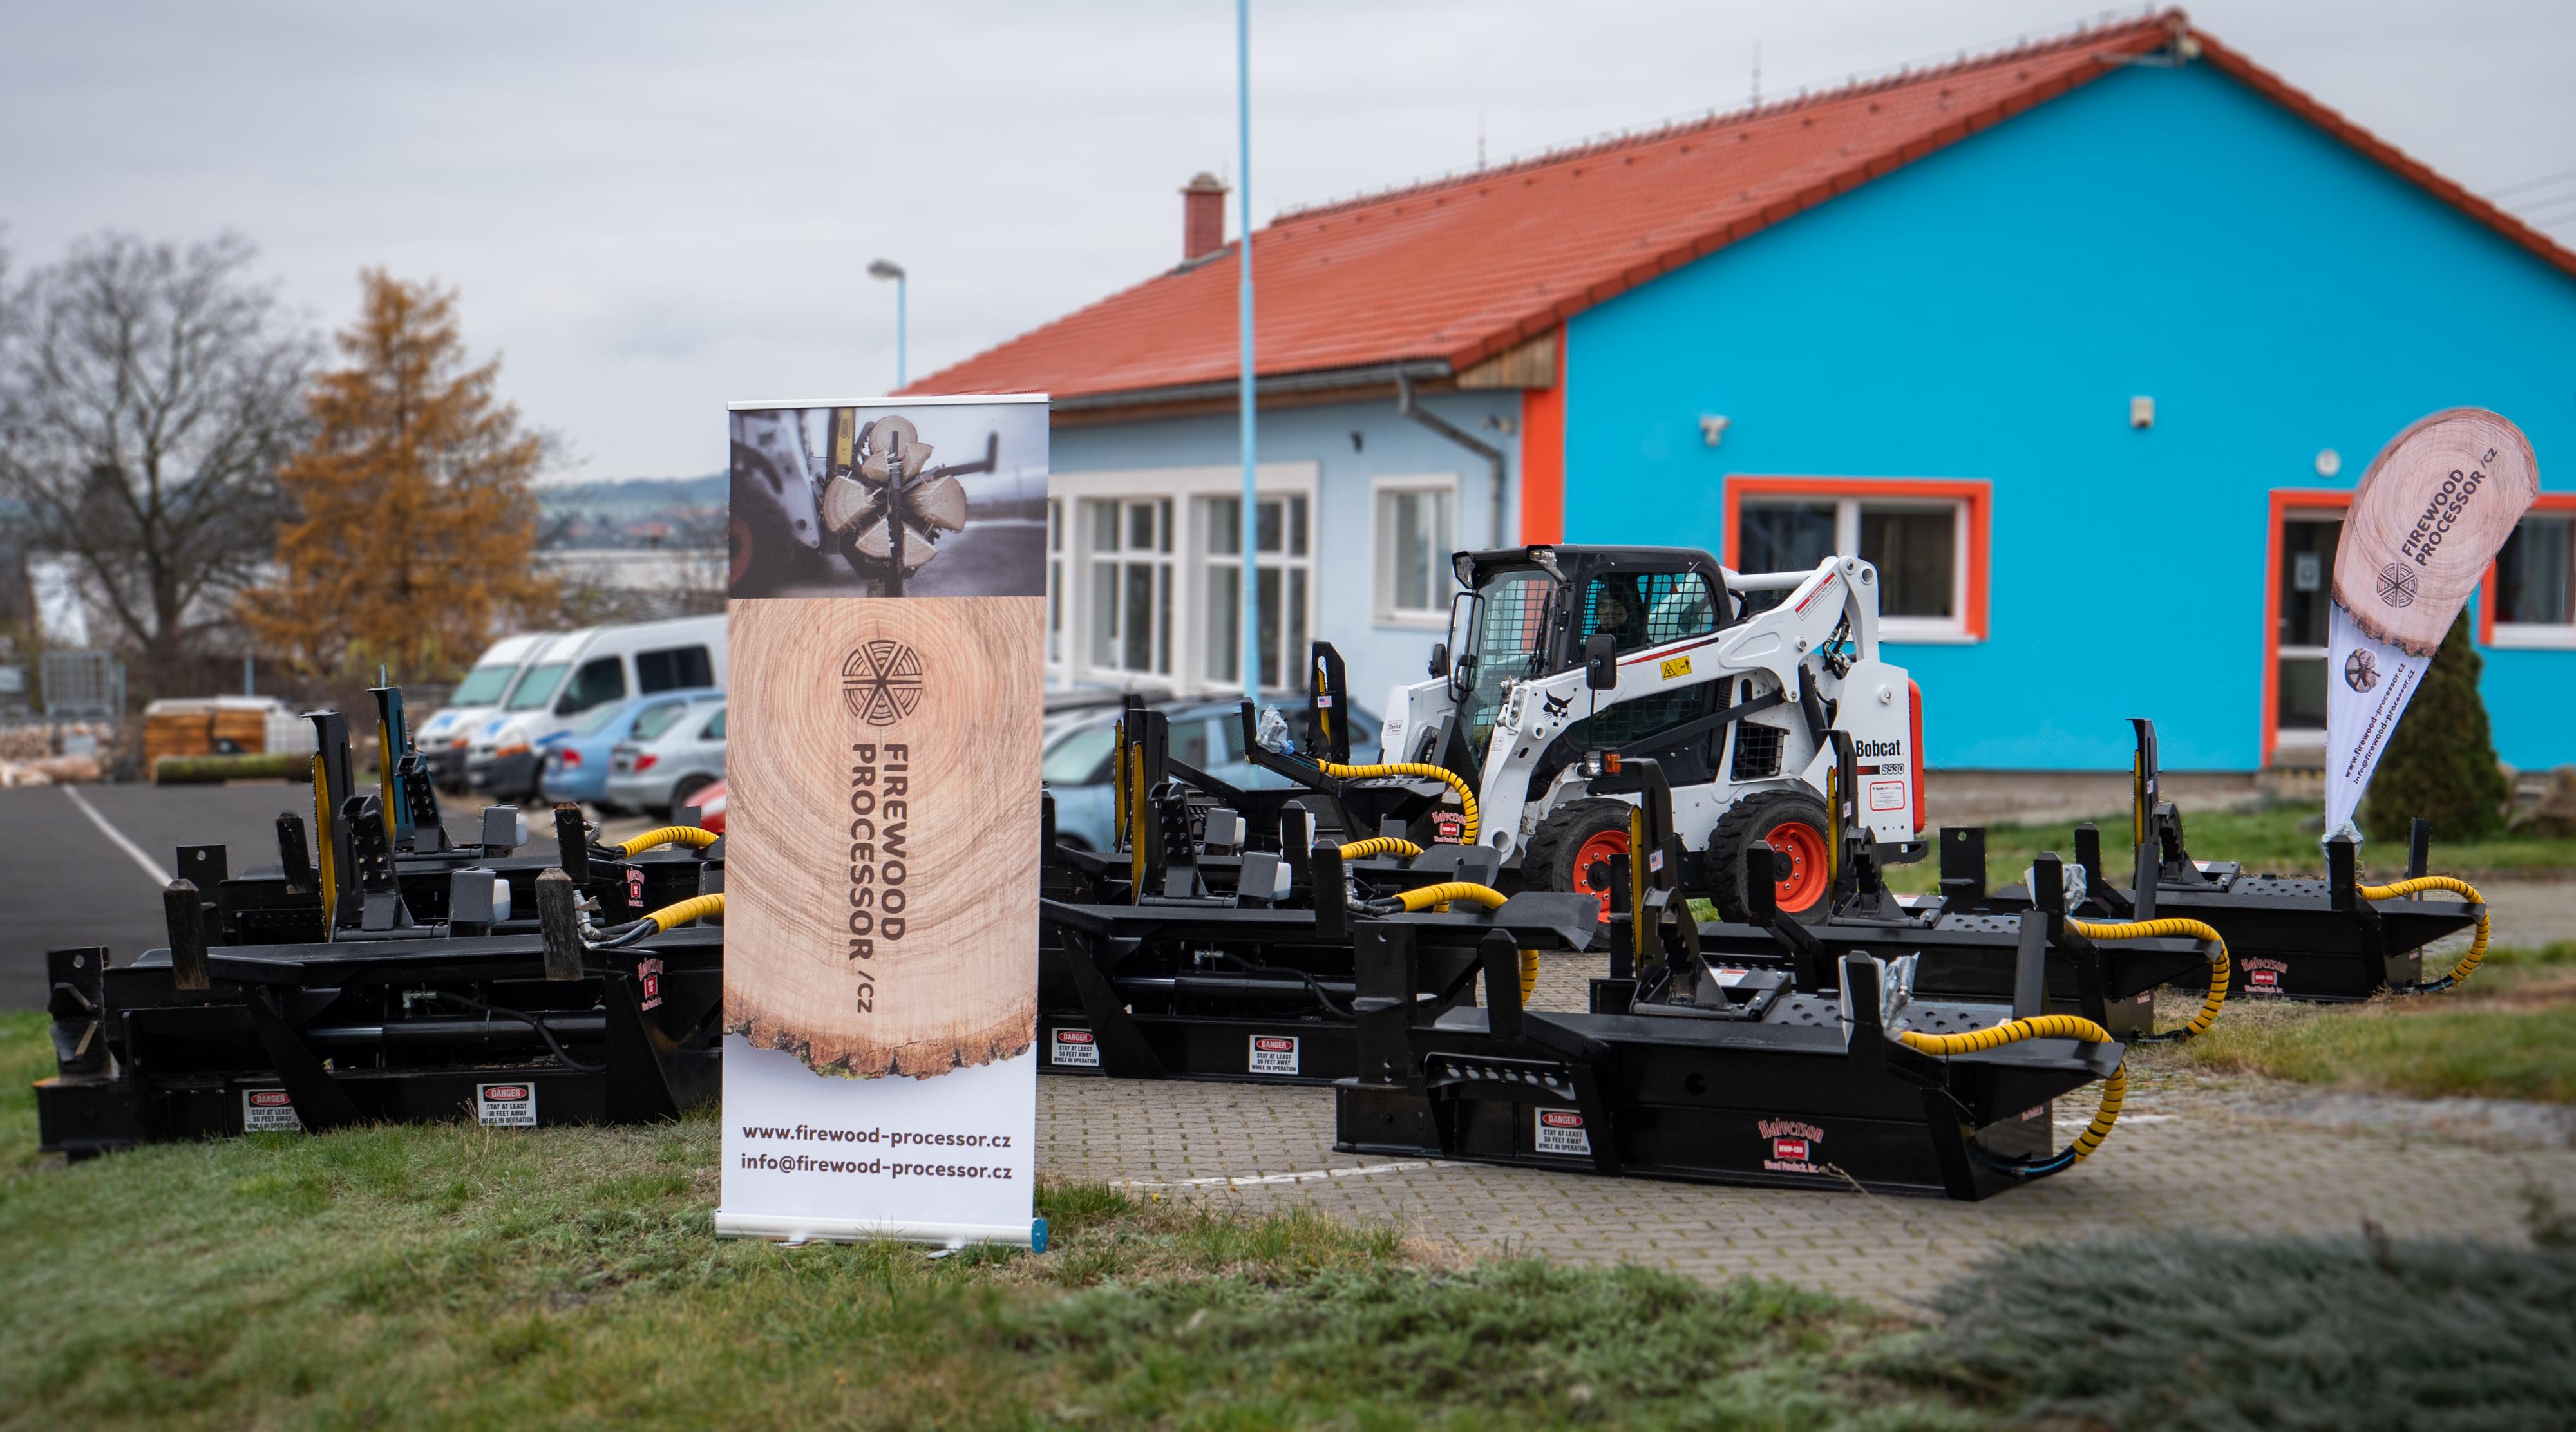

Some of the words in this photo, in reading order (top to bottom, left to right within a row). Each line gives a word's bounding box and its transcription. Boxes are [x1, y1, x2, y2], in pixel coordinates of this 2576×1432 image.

[2401, 469, 2464, 557] FIREWOOD
[2415, 471, 2486, 567] PROCESSOR
[2480, 448, 2498, 469] /CZ
[2345, 663, 2407, 778] www.firewood-processor.cz
[2353, 669, 2416, 784] info@firewood-processor.cz
[1855, 740, 1901, 757] Bobcat
[1881, 763, 1905, 775] S530
[849, 744, 876, 961] PROCESSOR
[880, 744, 908, 941] FIREWOOD
[857, 970, 875, 1013] /CZ
[1063, 1033, 1088, 1041] DANGER
[1262, 1041, 1287, 1049] DANGER
[256, 1095, 285, 1103] DANGER
[491, 1089, 520, 1097] DANGER
[1548, 1115, 1577, 1125] DANGER
[1758, 1117, 1824, 1144] Halverson
[743, 1124, 1012, 1148] www.firewood-processor.cz
[1561, 1144, 1589, 1153] OPERATION
[741, 1153, 1012, 1179] info@firewood-processor.cz
